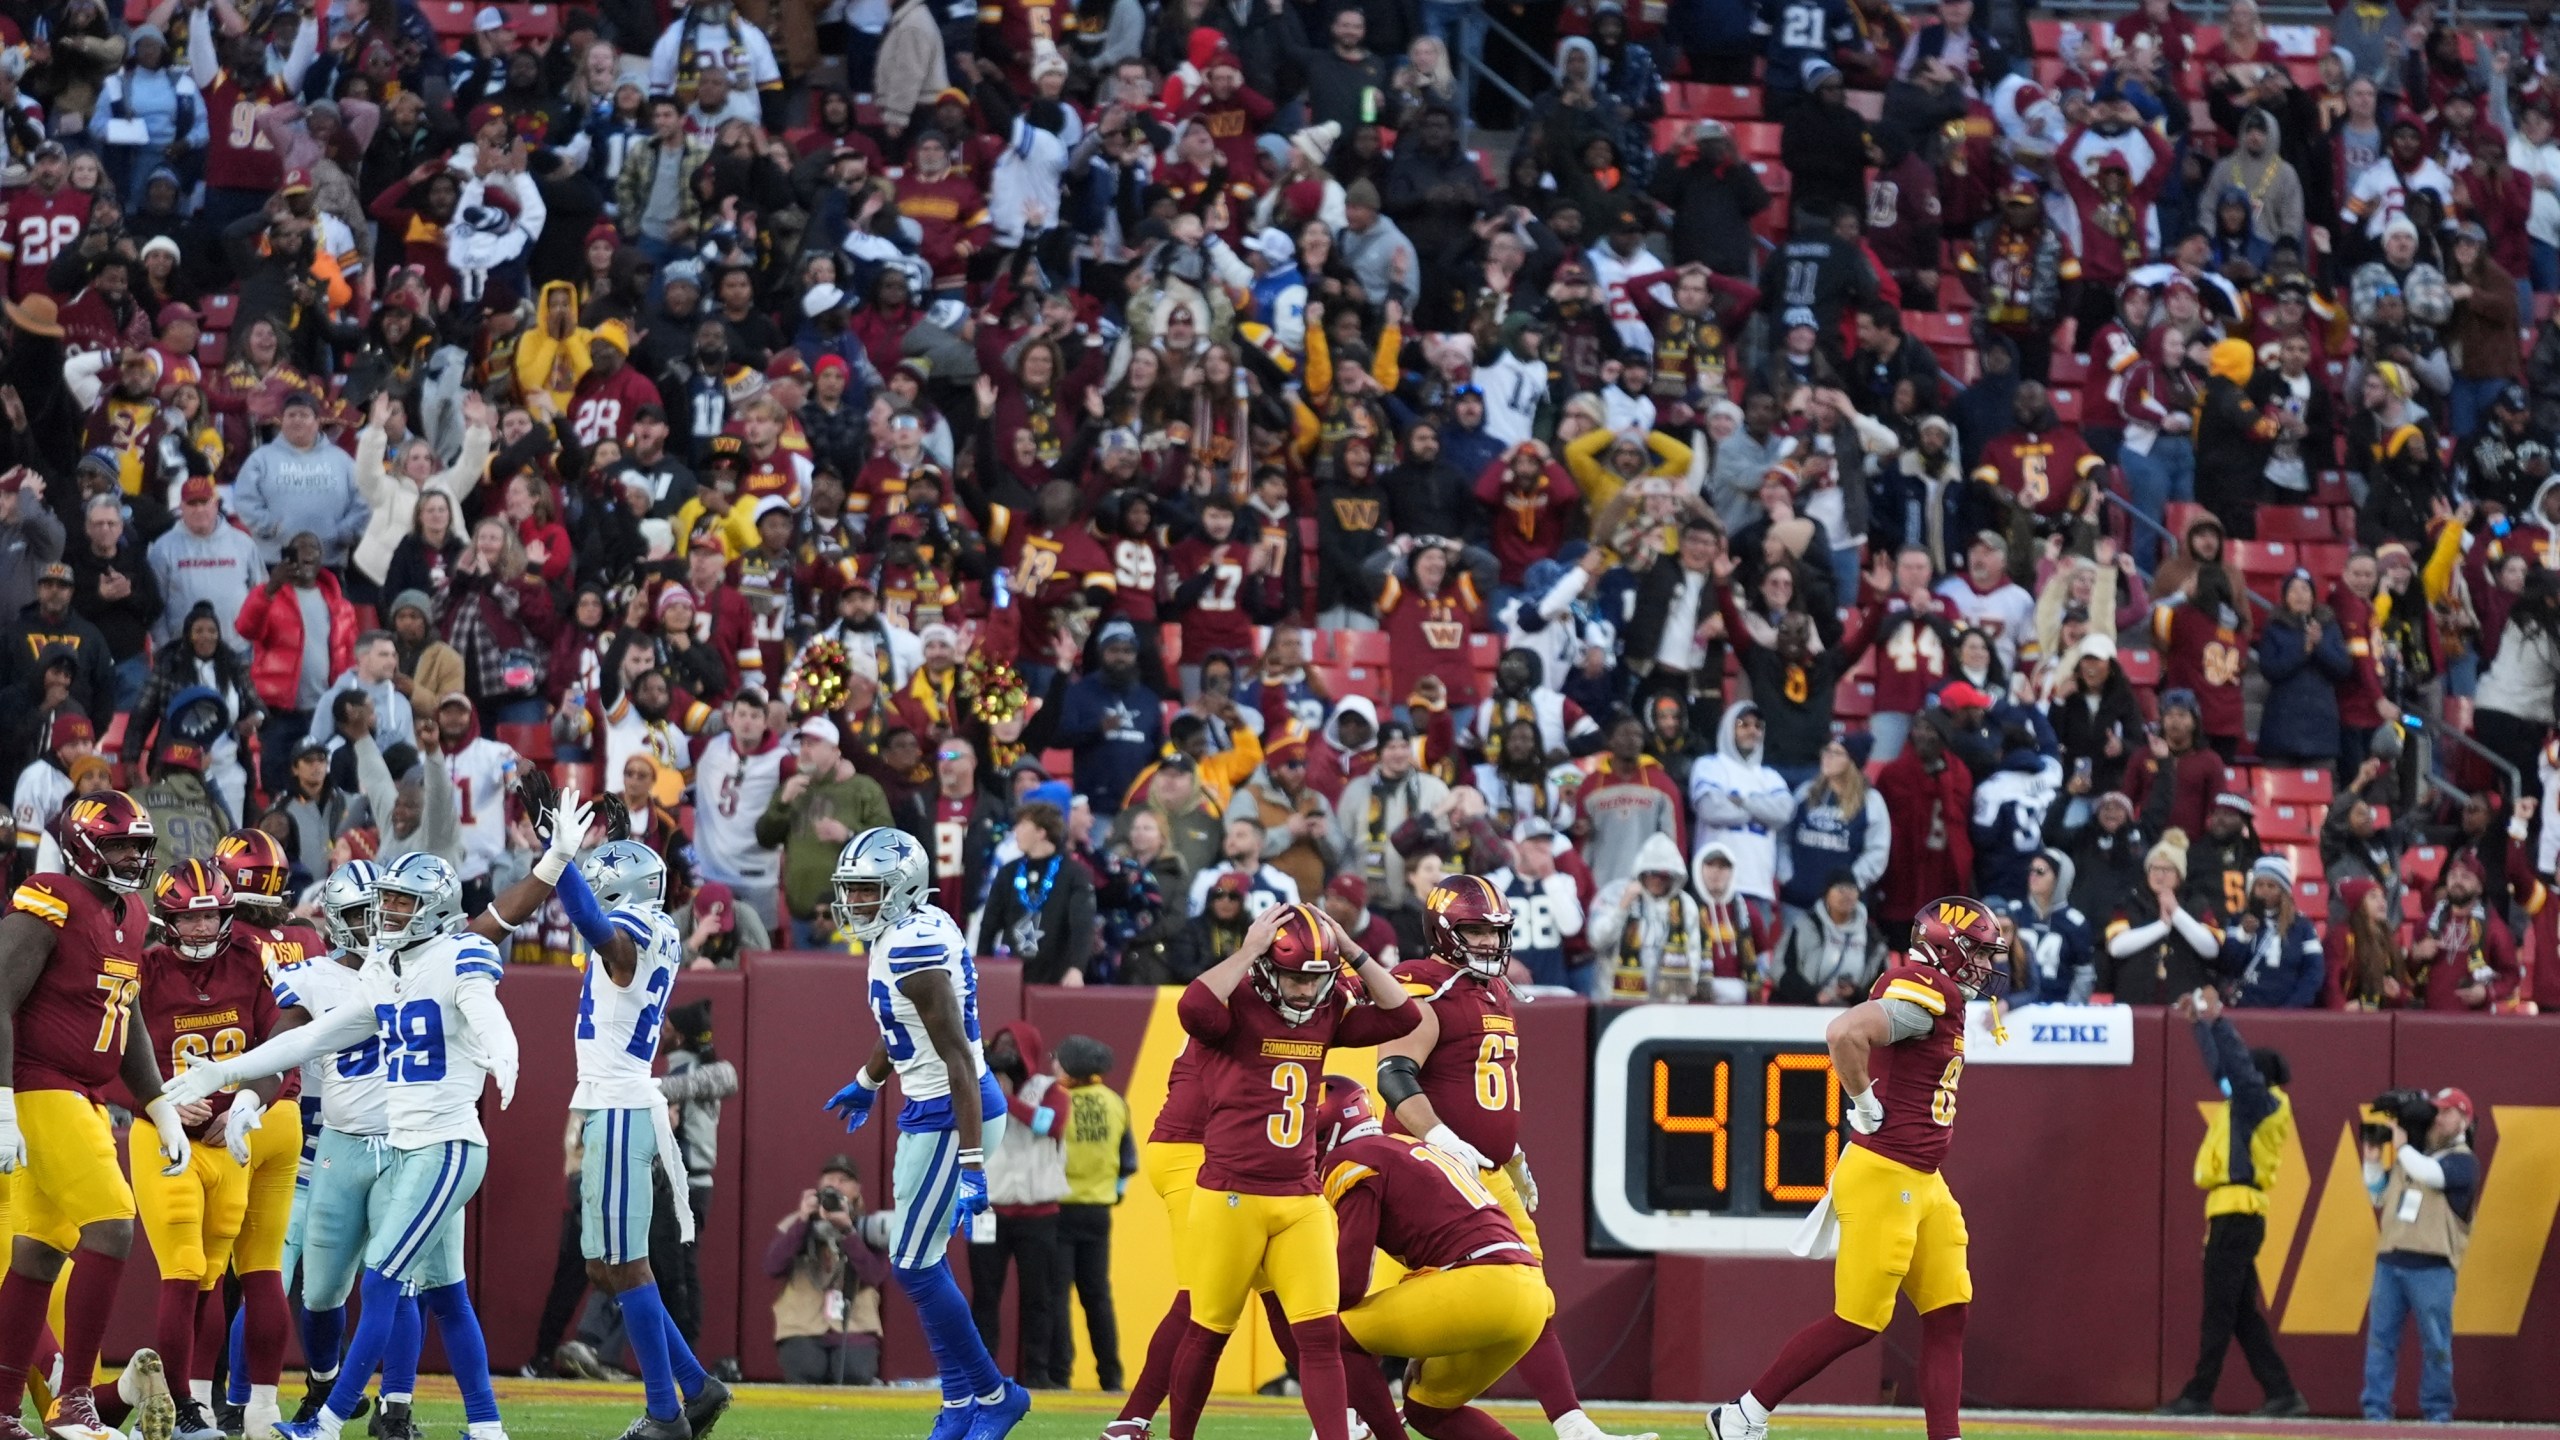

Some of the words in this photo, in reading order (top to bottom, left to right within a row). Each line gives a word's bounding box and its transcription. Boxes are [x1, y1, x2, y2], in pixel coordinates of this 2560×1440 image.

[1779, 6, 1825, 50] 21
[19, 215, 80, 265] 28
[576, 398, 621, 447] 28
[276, 475, 338, 489] COWBOYS
[280, 462, 333, 475] DALLAS
[1115, 540, 1157, 590] 99
[1885, 621, 1944, 677] 44
[717, 775, 740, 819] 5
[2223, 870, 2246, 915] 5
[270, 941, 304, 963] OSMI
[174, 1011, 239, 1031] COMMANDERS
[2032, 1025, 2108, 1043] ZEKE
[1261, 1041, 1324, 1058] COMMANDERS
[1073, 1109, 1107, 1127] EVENT
[1266, 1062, 1308, 1149] 3
[1653, 1053, 1840, 1201] 40
[1076, 1126, 1108, 1143] STAFF
